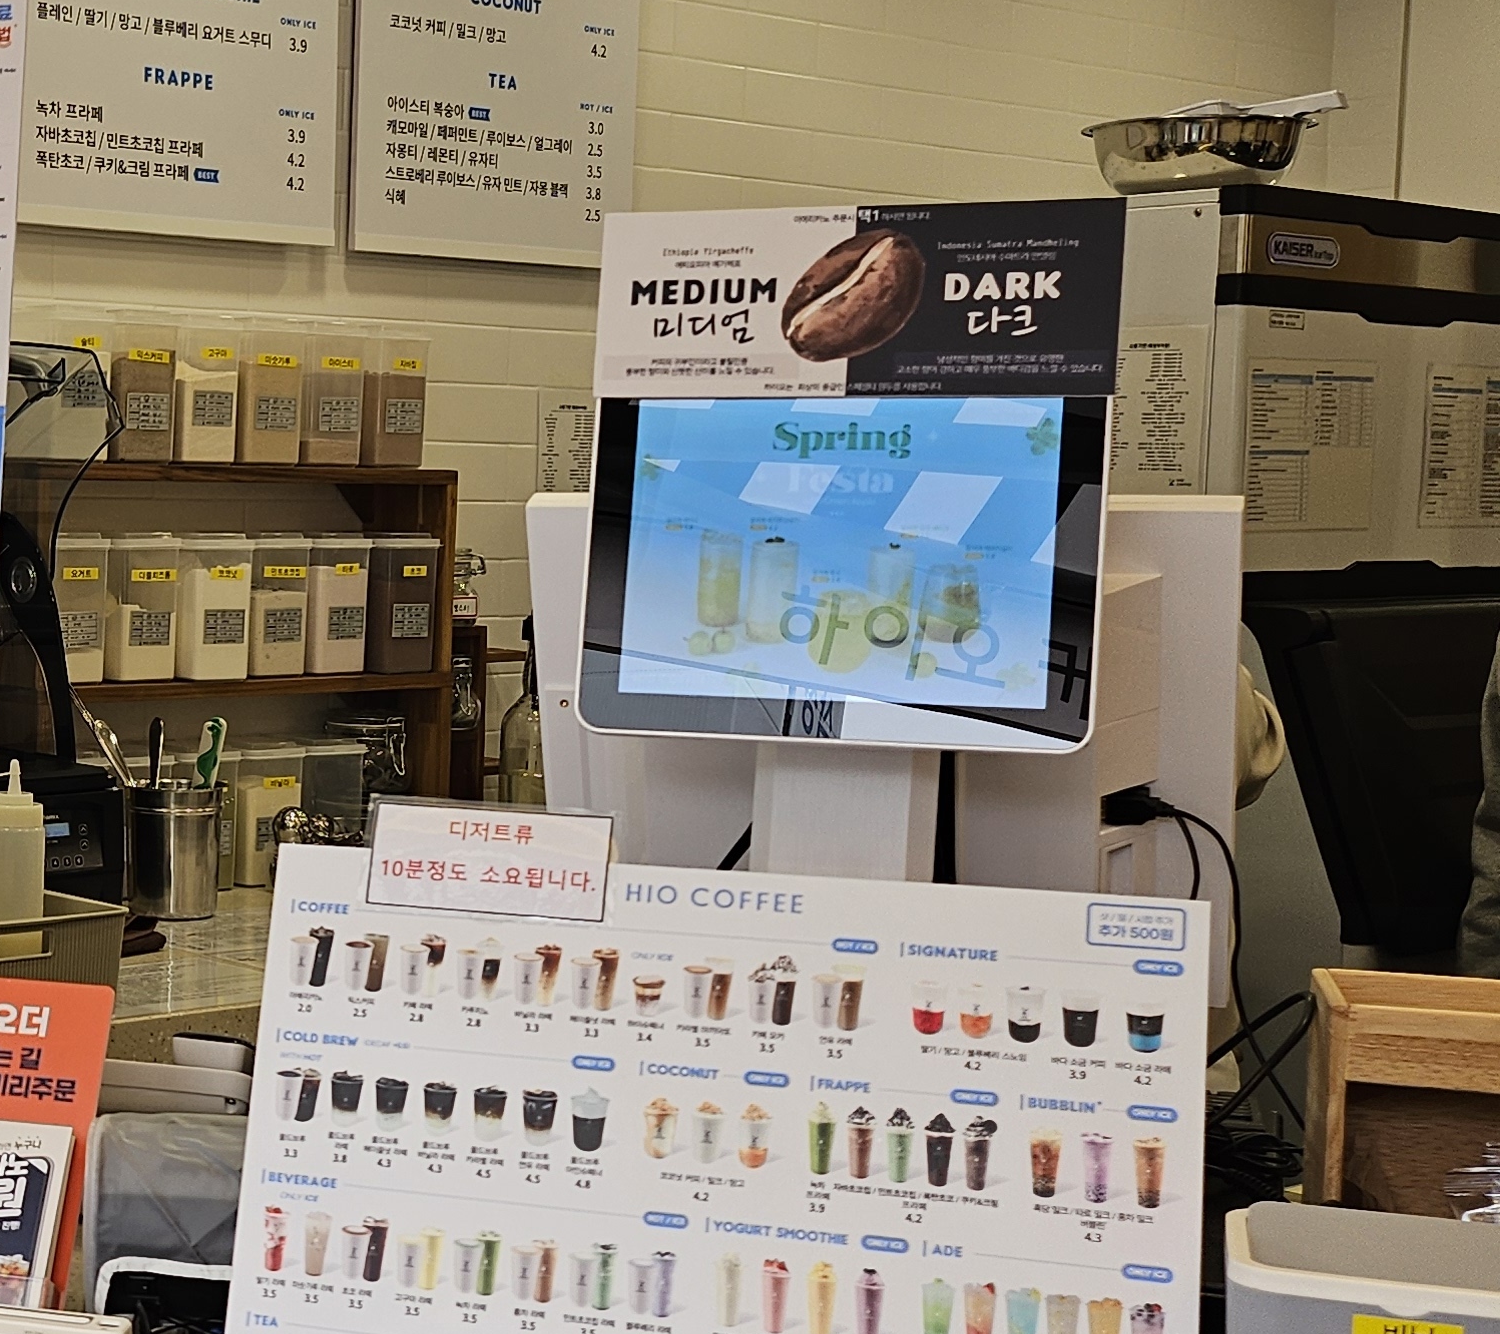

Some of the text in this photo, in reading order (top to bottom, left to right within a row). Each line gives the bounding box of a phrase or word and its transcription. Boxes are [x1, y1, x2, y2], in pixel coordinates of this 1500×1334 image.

[37, 2, 272, 49] 플레인 딸기 망고 블루베리 요거트 스무디
[289, 38, 307, 53] 3.9
[144, 67, 214, 90] FRAPPE
[489, 73, 516, 90] TEA
[36, 100, 103, 123] 녹차 프라페
[388, 97, 464, 119] 아이스티 복숭아
[588, 121, 604, 135] 3.0
[36, 127, 203, 158] 자바초코칩 민트초코칩 프라페
[486, 131, 526, 149] 루이보스
[534, 136, 572, 154] 얼그레이
[287, 154, 305, 168] 4.2
[585, 209, 600, 222] 2.5
[1274, 240, 1314, 257] KAISER
[631, 278, 778, 306] MEDIUM
[943, 271, 1061, 303] DARK
[654, 310, 754, 344] 미디엄
[967, 306, 1038, 336] 다크
[773, 421, 912, 459] Spring
[449, 821, 534, 845] 디저트류
[381, 858, 596, 893] 10분정도 소요됩니다.
[298, 902, 348, 914] COFFEE
[626, 883, 804, 914] HIO COFFEE
[908, 944, 998, 961] SIGNATURE
[283, 1031, 358, 1047] COLD BREW
[20, 1047, 42, 1070] 길
[932, 1245, 963, 1258] ADE
[254, 1315, 279, 1327] TEA
